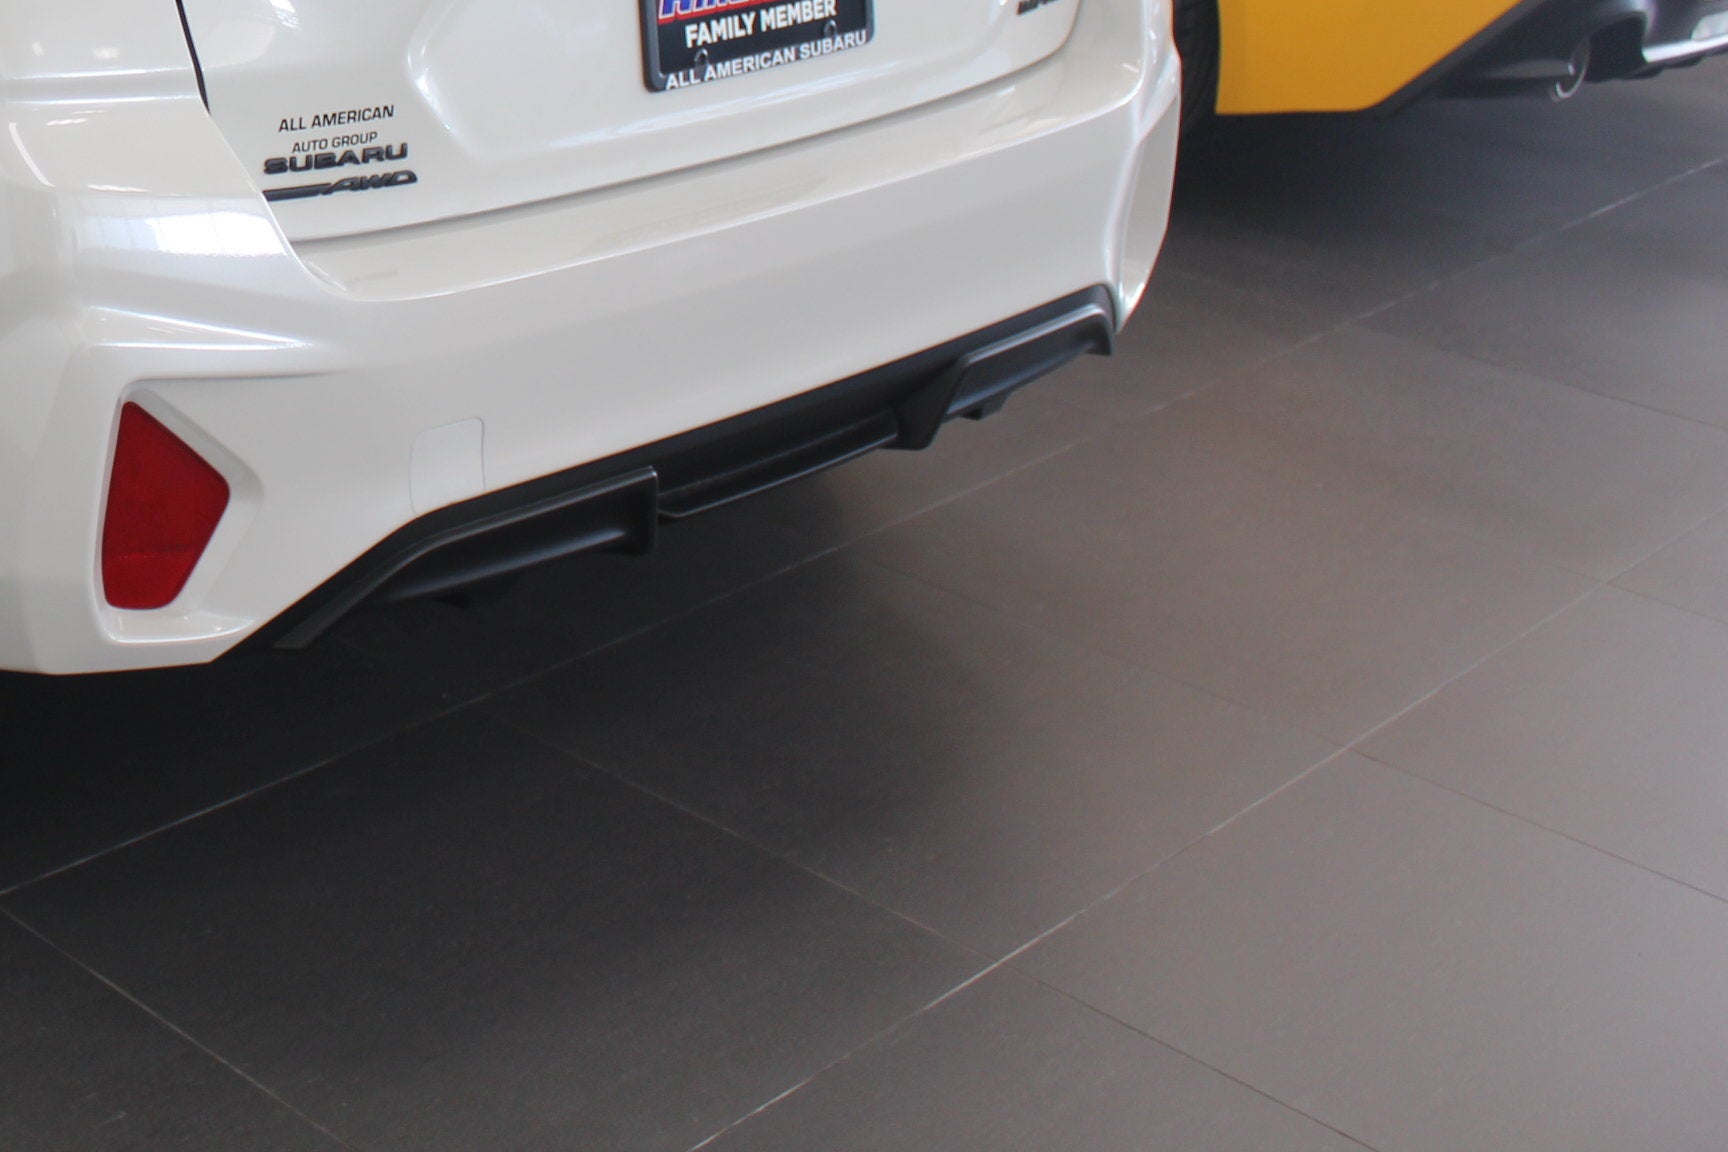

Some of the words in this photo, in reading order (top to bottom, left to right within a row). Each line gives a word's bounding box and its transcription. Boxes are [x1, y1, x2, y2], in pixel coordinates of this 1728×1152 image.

[685, 12, 756, 48] FAMILY
[665, 71, 701, 90] ALL
[704, 46, 797, 81] AMERICAN
[800, 29, 868, 59] SUBARU
[278, 117, 307, 133] ALL
[311, 105, 394, 129] AMERICAN
[292, 138, 328, 154] AUTO
[332, 131, 378, 149] GROUP
[263, 142, 408, 174] SUBARU
[324, 169, 418, 195] AWD
